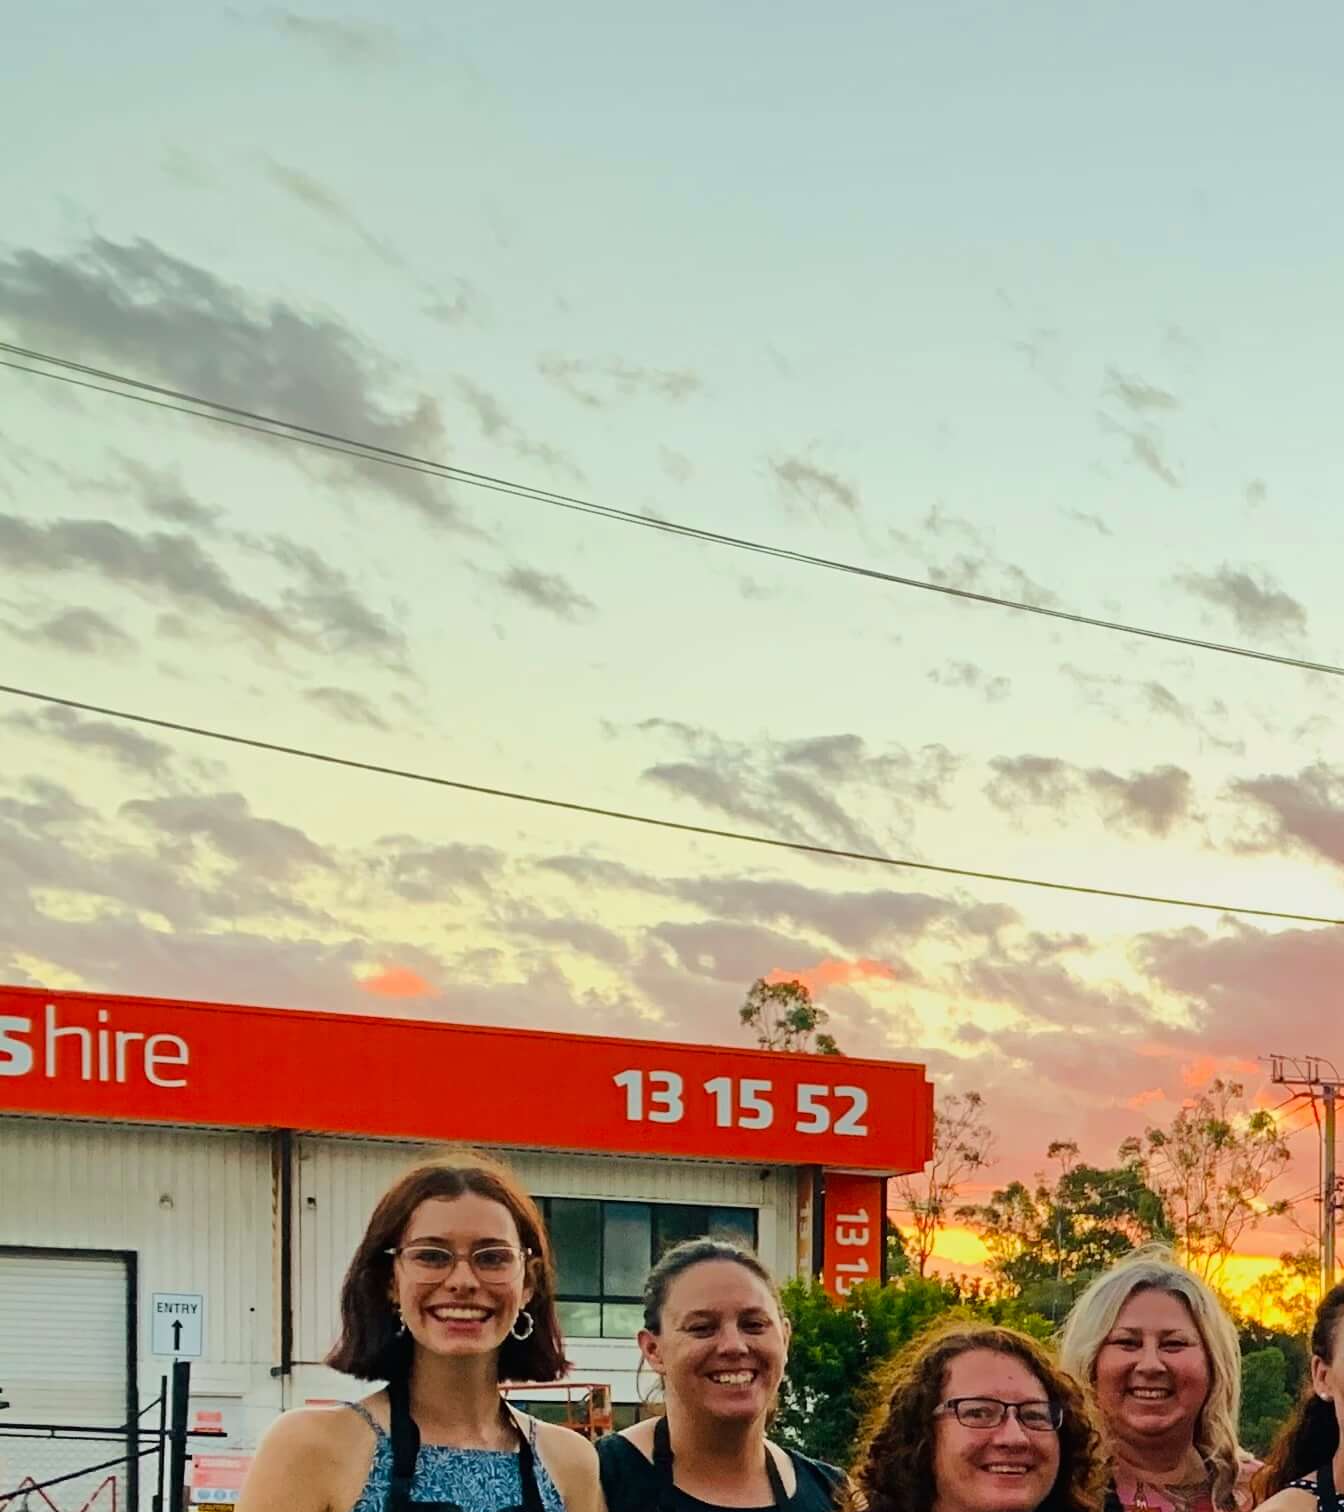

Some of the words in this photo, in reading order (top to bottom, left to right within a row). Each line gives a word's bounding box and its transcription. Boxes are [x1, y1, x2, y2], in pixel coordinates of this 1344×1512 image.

[612, 1069, 685, 1123] 13
[703, 1076, 774, 1130] 15
[795, 1083, 869, 1137] 52
[835, 1208, 870, 1246] 13
[156, 1301, 199, 1315] ENTRY
